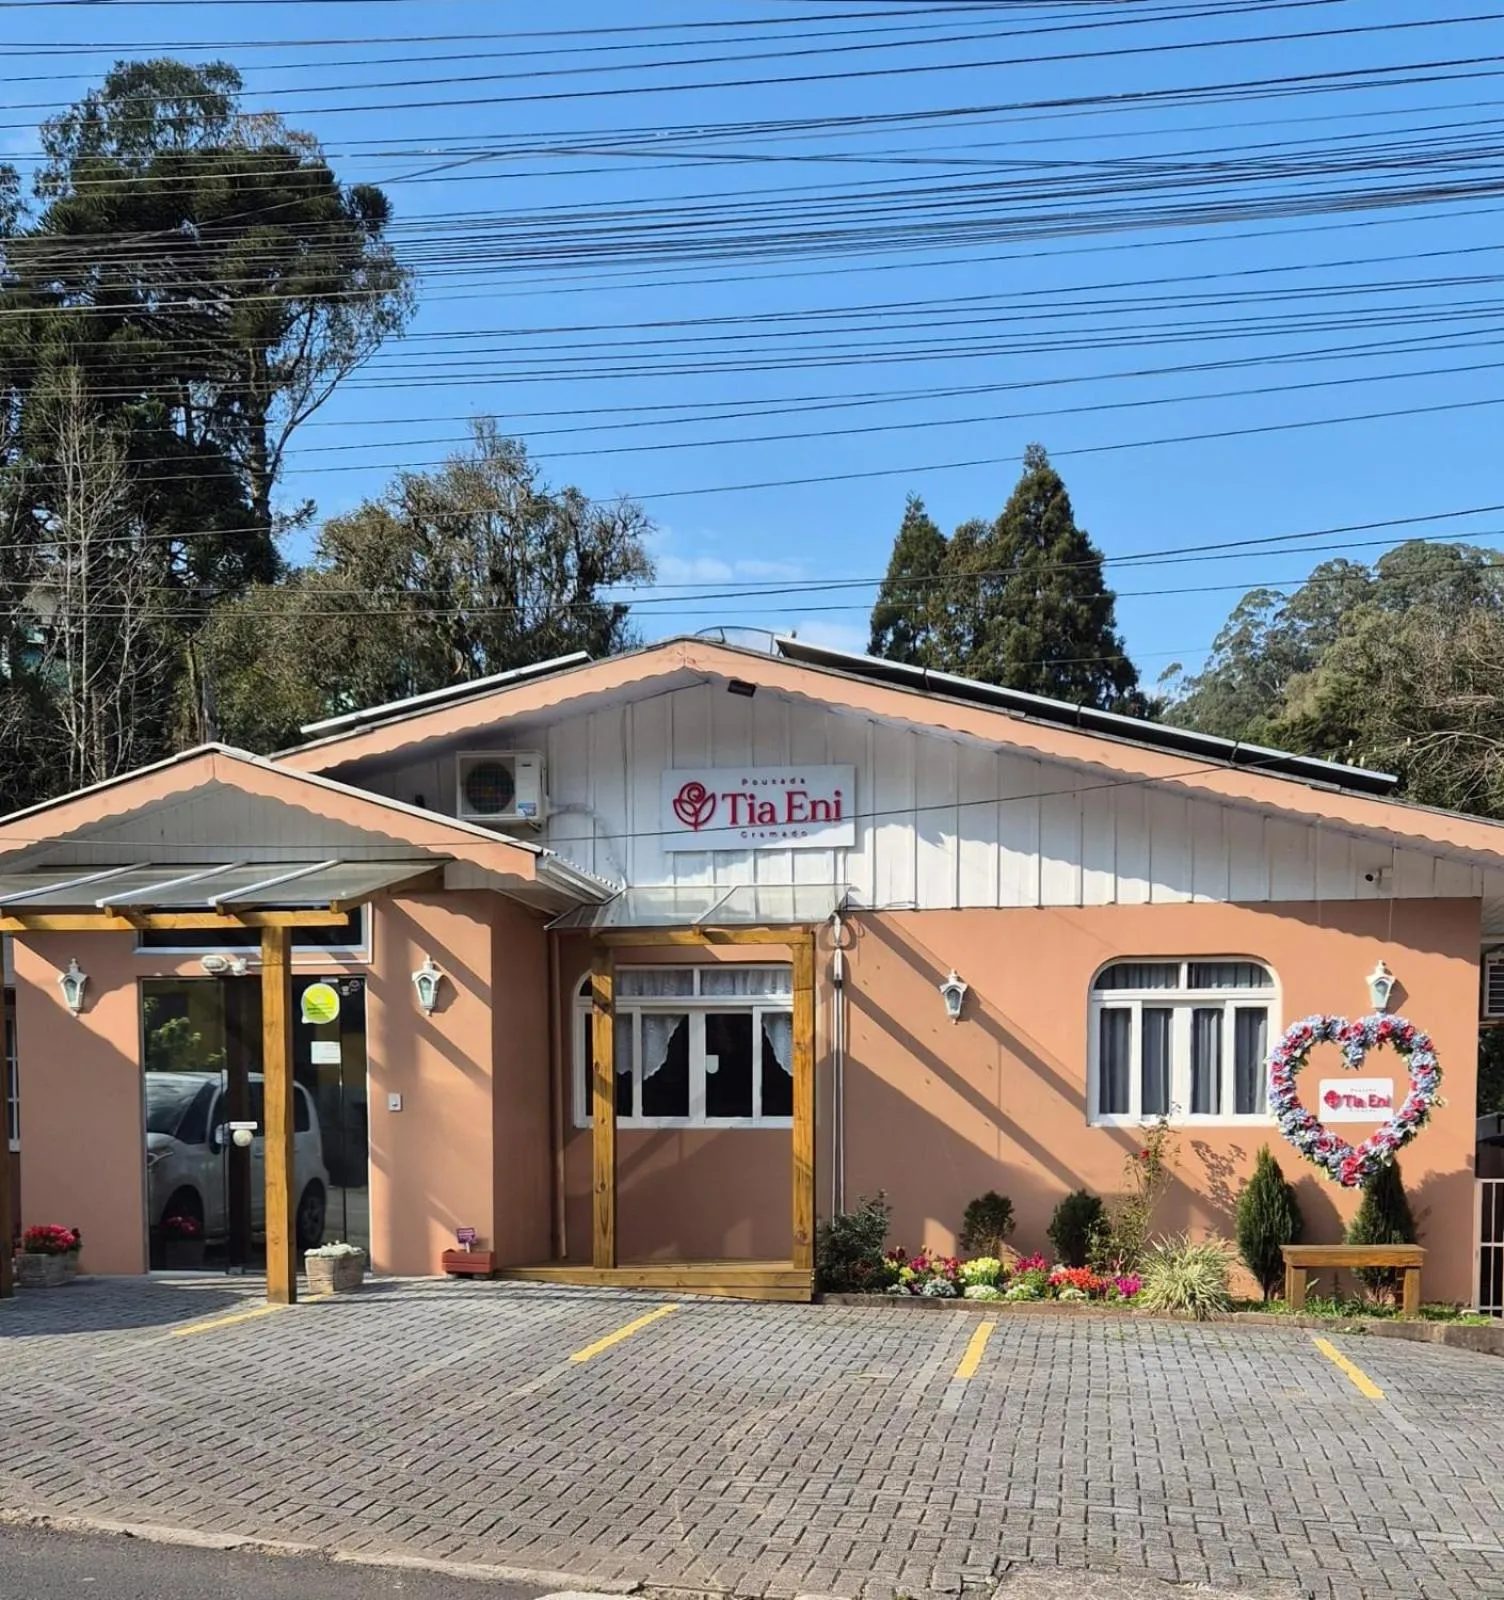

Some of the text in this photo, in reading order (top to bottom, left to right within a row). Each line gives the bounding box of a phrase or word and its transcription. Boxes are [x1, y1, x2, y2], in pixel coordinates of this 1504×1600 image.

[741, 777, 806, 786] Pousada
[721, 790, 843, 825] Tia Eni
[740, 830, 808, 839] Gramado
[1342, 1093, 1392, 1108] Tia Eni
